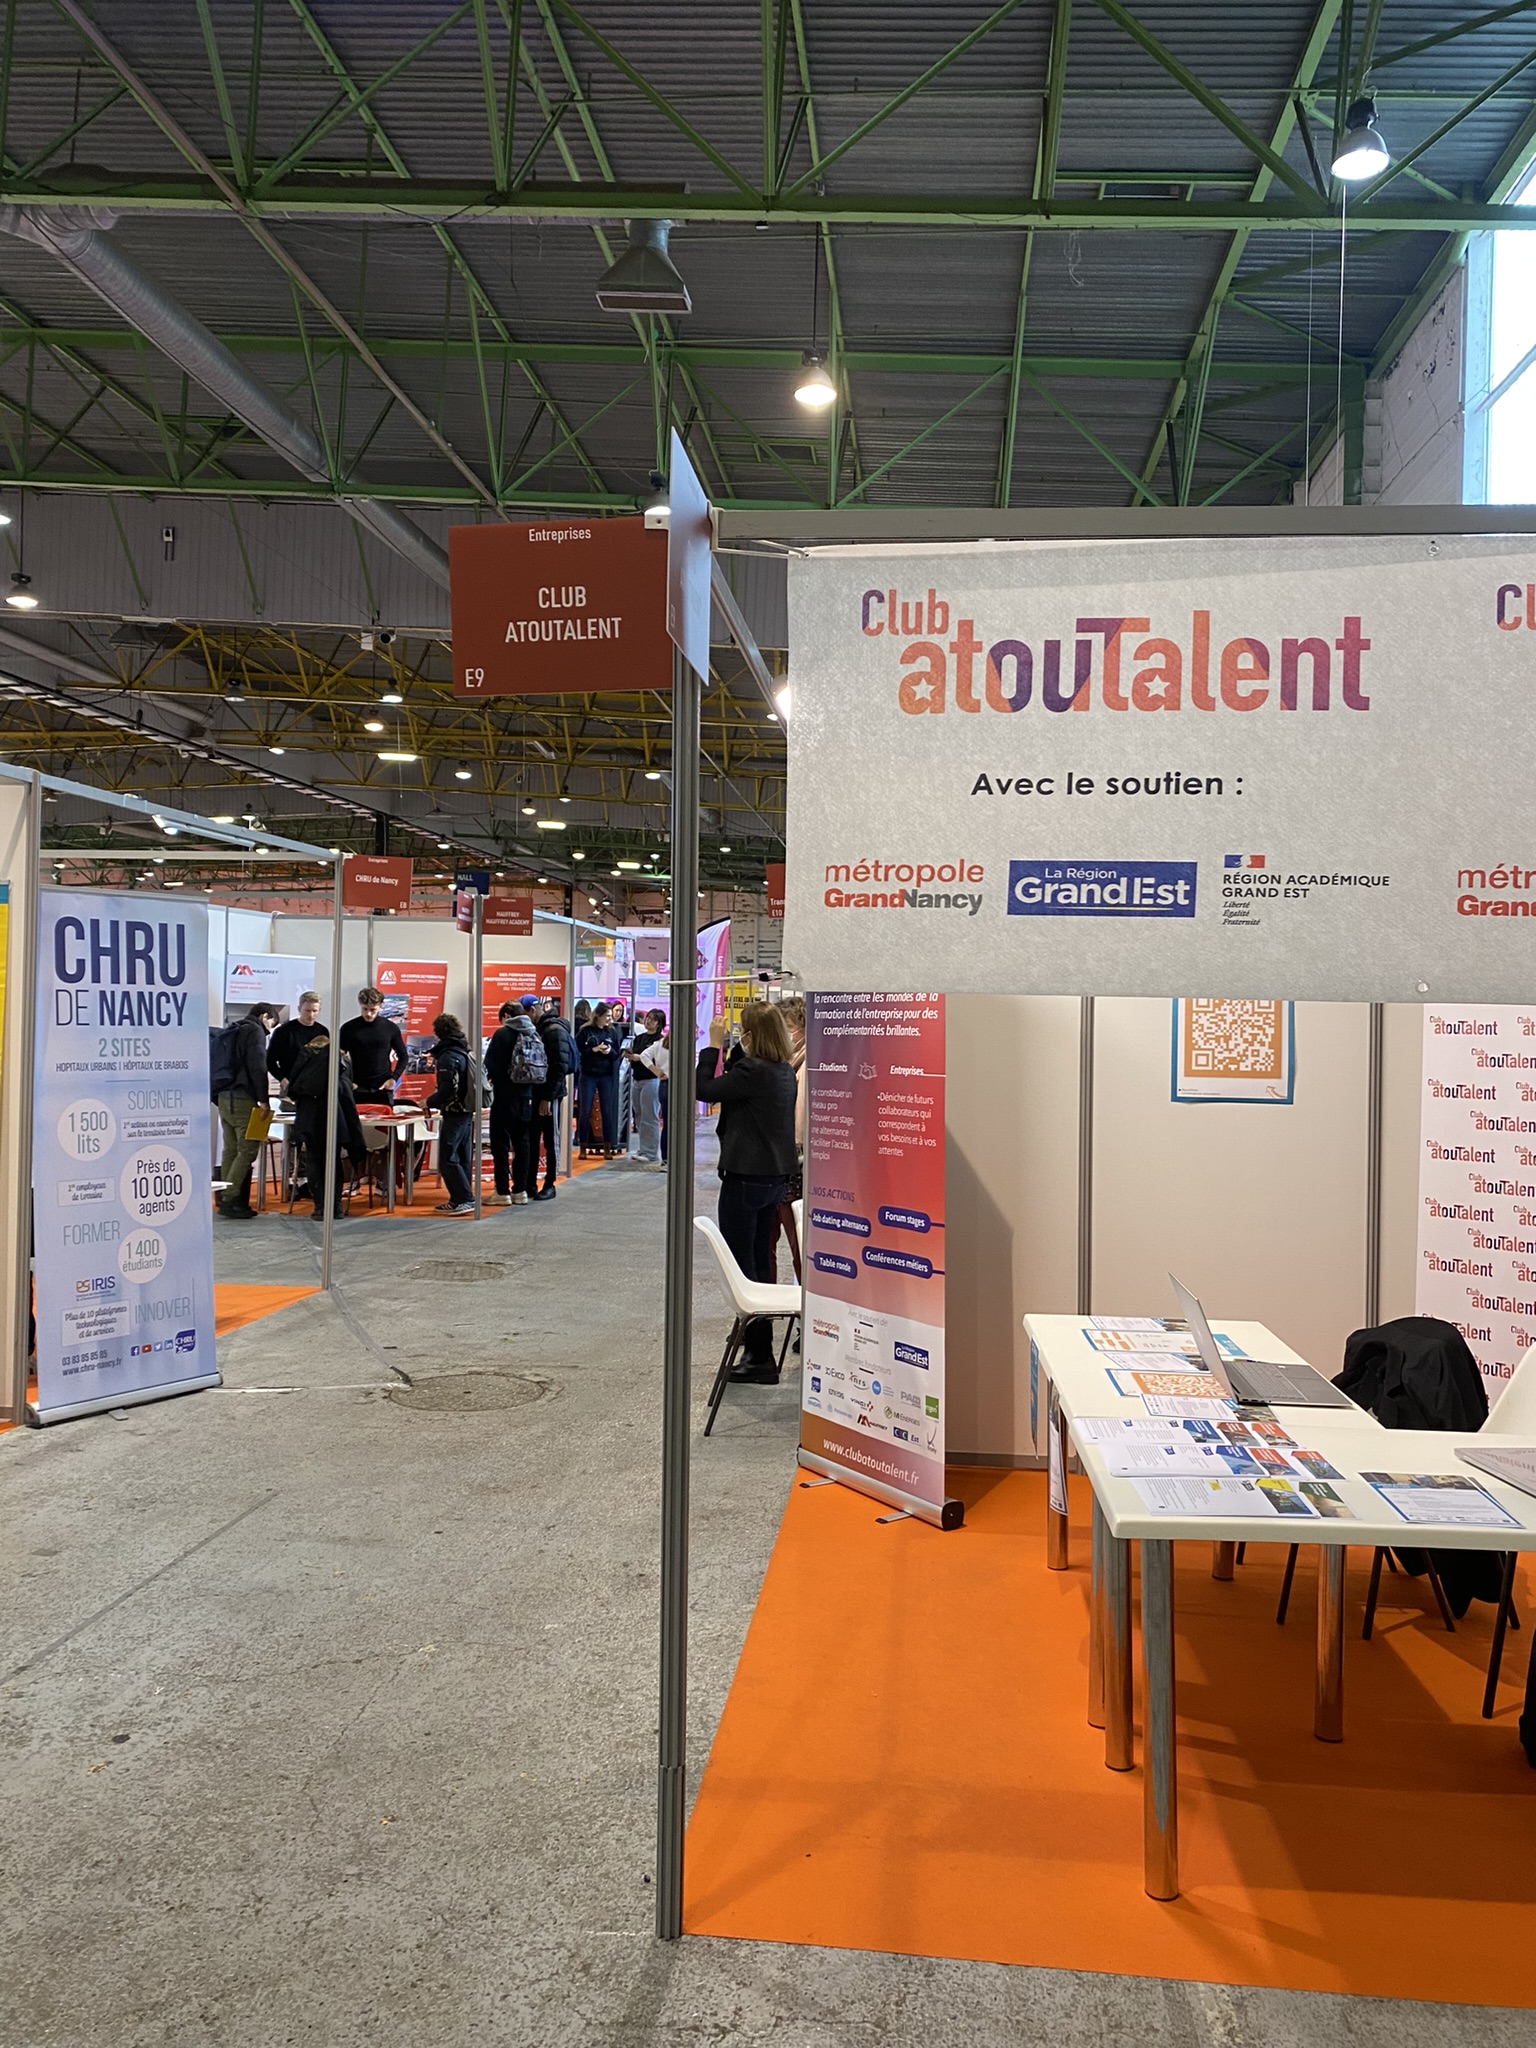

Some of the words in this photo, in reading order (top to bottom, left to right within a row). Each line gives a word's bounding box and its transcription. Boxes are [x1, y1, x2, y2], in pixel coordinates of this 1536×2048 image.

[529, 527, 591, 543] Entreprises
[538, 586, 586, 608] CLUB
[862, 588, 949, 636] Club
[505, 617, 622, 644] ATOUTALENT
[898, 610, 1371, 715] atouTalent
[465, 668, 484, 688] E9
[971, 772, 1055, 796] Avec
[1066, 772, 1095, 796] le
[1105, 772, 1224, 796] soutien
[355, 874, 372, 883] CHRU
[372, 875, 379, 883] de
[380, 876, 399, 886] Nancy
[456, 874, 474, 882] HALL
[825, 858, 984, 888] métropole
[1045, 868, 1062, 879] La
[1066, 867, 1117, 881] Région
[1223, 872, 1281, 885] RÉGION
[1286, 873, 1390, 888] ACADÉMIQUE
[1222, 888, 1279, 898] GRAND
[1284, 888, 1310, 898] EST
[770, 898, 786, 907] Tran
[1222, 909, 1250, 918] Égalité
[1222, 918, 1260, 926] Fraternité
[54, 916, 186, 987] CHRU
[821, 994, 852, 1003] rencontre
[853, 994, 870, 1003] entre
[872, 992, 884, 1002] les
[886, 992, 914, 1002] mondes
[915, 992, 926, 1001] de
[56, 989, 90, 1026] DE
[99, 990, 188, 1027] NANCY
[814, 1008, 845, 1020] formation
[846, 1010, 853, 1019] et
[853, 1008, 862, 1018] de
[862, 1008, 903, 1021] l'entreprise
[904, 1010, 921, 1021] pour
[922, 1007, 938, 1019] des
[823, 1024, 885, 1037] complémentarités
[886, 1024, 921, 1036] brillantes.
[1434, 1020, 1498, 1035] atouTalent
[98, 1038, 107, 1057] 2
[111, 1038, 151, 1057] SITES
[1471, 1048, 1485, 1056] Club
[90, 1062, 117, 1071] URBAINS
[155, 1061, 163, 1070] DE
[163, 1060, 189, 1070] BRABOIS
[819, 1062, 848, 1072] Etudiants
[890, 1065, 923, 1077] Entreprises
[127, 1089, 183, 1110] SOIGNER
[907, 1094, 914, 1103] de
[914, 1094, 934, 1105] futurs
[1432, 1084, 1496, 1100] atouTalent
[827, 1103, 838, 1111] pro
[878, 1106, 920, 1118] collaborateurs
[920, 1109, 932, 1119] qui
[68, 1112, 75, 1132] 1
[80, 1110, 108, 1132] 500
[831, 1115, 839, 1123] un
[878, 1120, 920, 1132] correspondent
[819, 1127, 849, 1137] alternance
[77, 1134, 100, 1154] lits
[878, 1134, 890, 1142] vos
[890, 1133, 911, 1144] besoins
[911, 1136, 918, 1145] et
[924, 1138, 937, 1147] vos
[878, 1147, 904, 1157] attentes
[1431, 1146, 1495, 1163] atouTalent
[137, 1160, 160, 1174] Près
[163, 1158, 176, 1172] de
[1469, 1173, 1482, 1181] Club
[132, 1177, 149, 1199] 10
[153, 1174, 183, 1197] 000
[813, 1186, 826, 1197] NOS
[827, 1188, 855, 1202] ACTIONS
[139, 1199, 175, 1216] agents
[1430, 1203, 1494, 1222] atouTalent
[1513, 1205, 1527, 1214] Club
[812, 1213, 821, 1222] Job
[822, 1214, 841, 1228] dating
[841, 1218, 869, 1232] alternance
[885, 1211, 906, 1223] Forum
[907, 1215, 925, 1228] stages
[63, 1221, 120, 1246] FORMER
[1468, 1228, 1481, 1237] Club
[135, 1239, 160, 1257] 400
[1424, 1251, 1436, 1259] Club
[122, 1258, 163, 1272] étudiants
[819, 1257, 836, 1268] Table
[836, 1262, 851, 1273] ronde
[866, 1251, 905, 1267] Conférences
[906, 1259, 928, 1273] métiers
[1429, 1256, 1493, 1277] atouTalent
[1512, 1261, 1526, 1270] Club
[1466, 1288, 1480, 1297] Club
[135, 1297, 191, 1324] INNOVER
[813, 1318, 840, 1332] métropole
[1511, 1326, 1525, 1335] Club
[62, 1357, 70, 1366] 03
[71, 1355, 80, 1365] 83
[62, 1358, 122, 1376] www.chru-nancy.fr
[823, 1439, 919, 1486] www.clubatoutalent.fr
